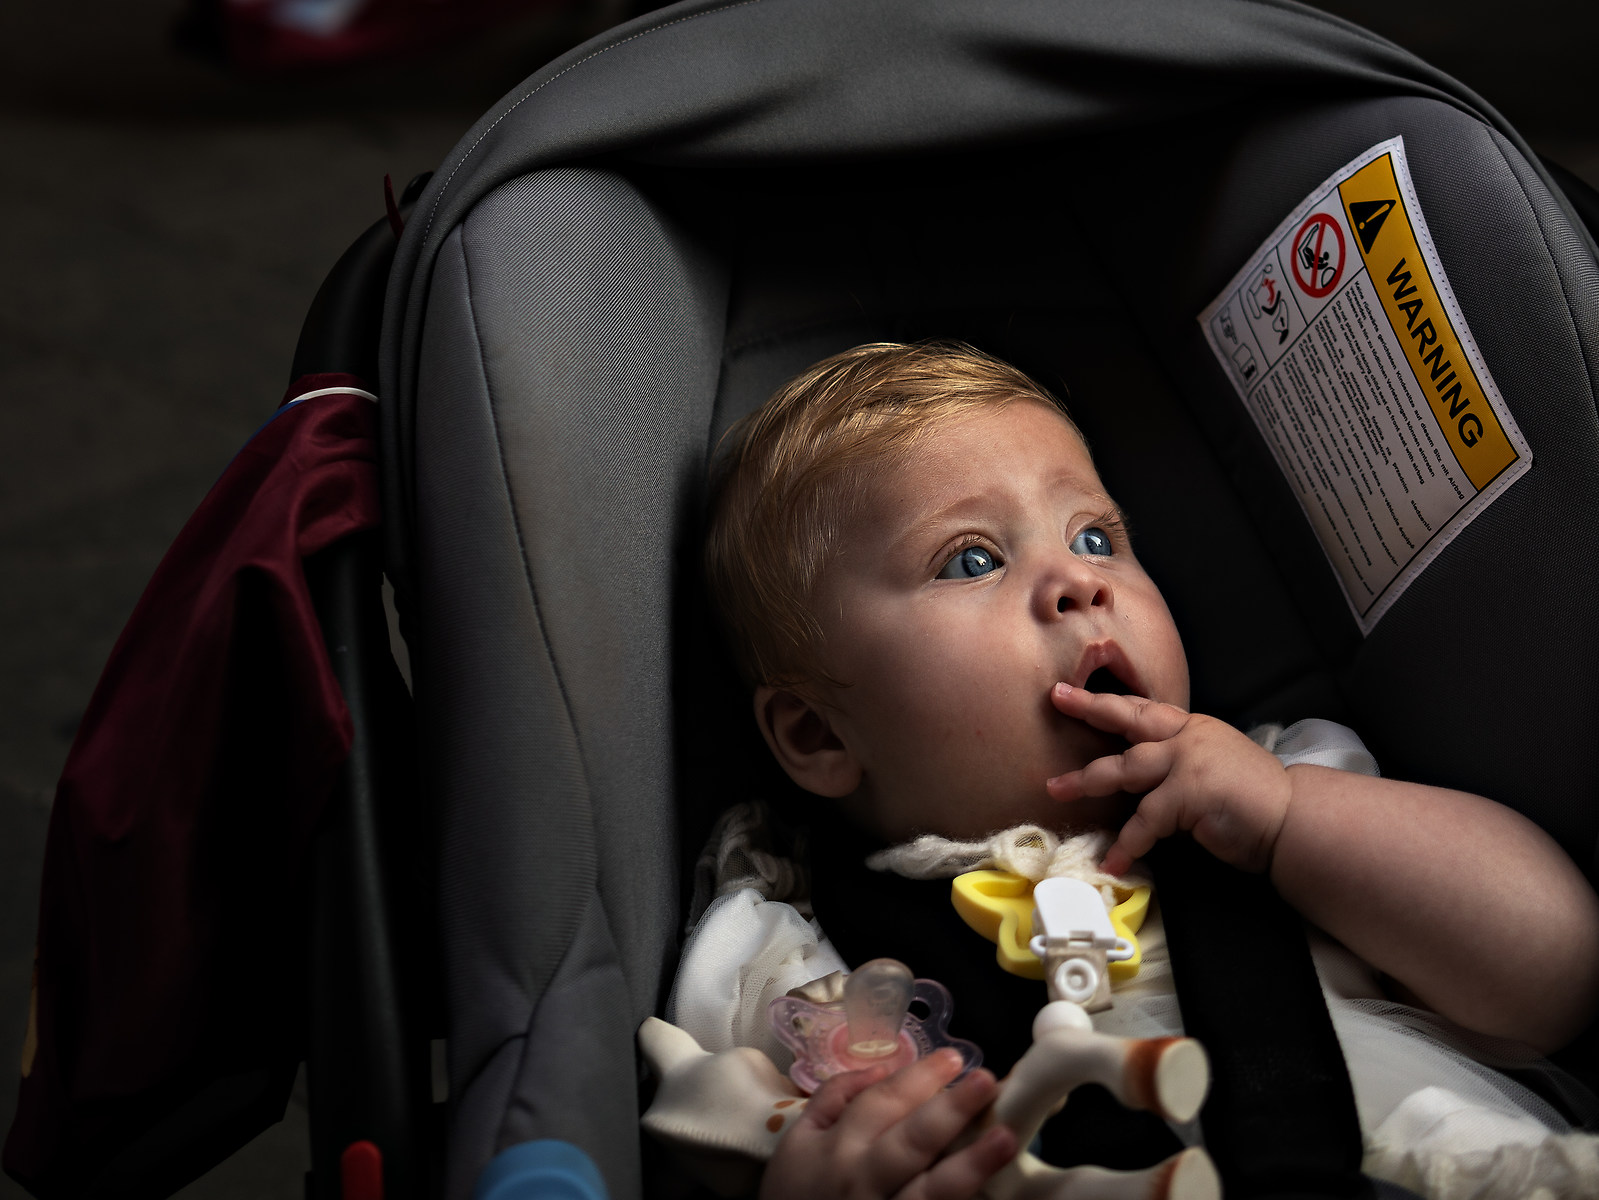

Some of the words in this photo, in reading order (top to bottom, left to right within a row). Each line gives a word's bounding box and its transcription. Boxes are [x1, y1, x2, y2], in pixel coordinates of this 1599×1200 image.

[1335, 299, 1342, 311] Do
[1340, 310, 1348, 322] not
[1344, 321, 1355, 339] place
[1369, 373, 1381, 391] child
[1378, 390, 1388, 406] seat
[1385, 405, 1392, 415] on
[1389, 414, 1400, 432] front
[1397, 431, 1407, 447] seat
[1404, 446, 1414, 462] with
[1411, 461, 1425, 485] airbag
[1339, 323, 1345, 331] or
[1343, 331, 1356, 356] serious
[1354, 354, 1366, 374] injury
[1363, 374, 1372, 387] can
[1370, 386, 1381, 406] occur
[1366, 339, 1373, 349] zu
[1385, 377, 1408, 422] Verletzungen
[1405, 420, 1420, 447] können
[1417, 446, 1435, 477] eintreten
[1386, 257, 1484, 449] WARNING
[1395, 369, 1415, 408] Kindersitze
[1413, 408, 1423, 421] auf
[1419, 421, 1434, 447] diesem
[1432, 447, 1442, 463] Sitz
[1439, 463, 1449, 476] mit
[1447, 476, 1465, 500] Airbag
